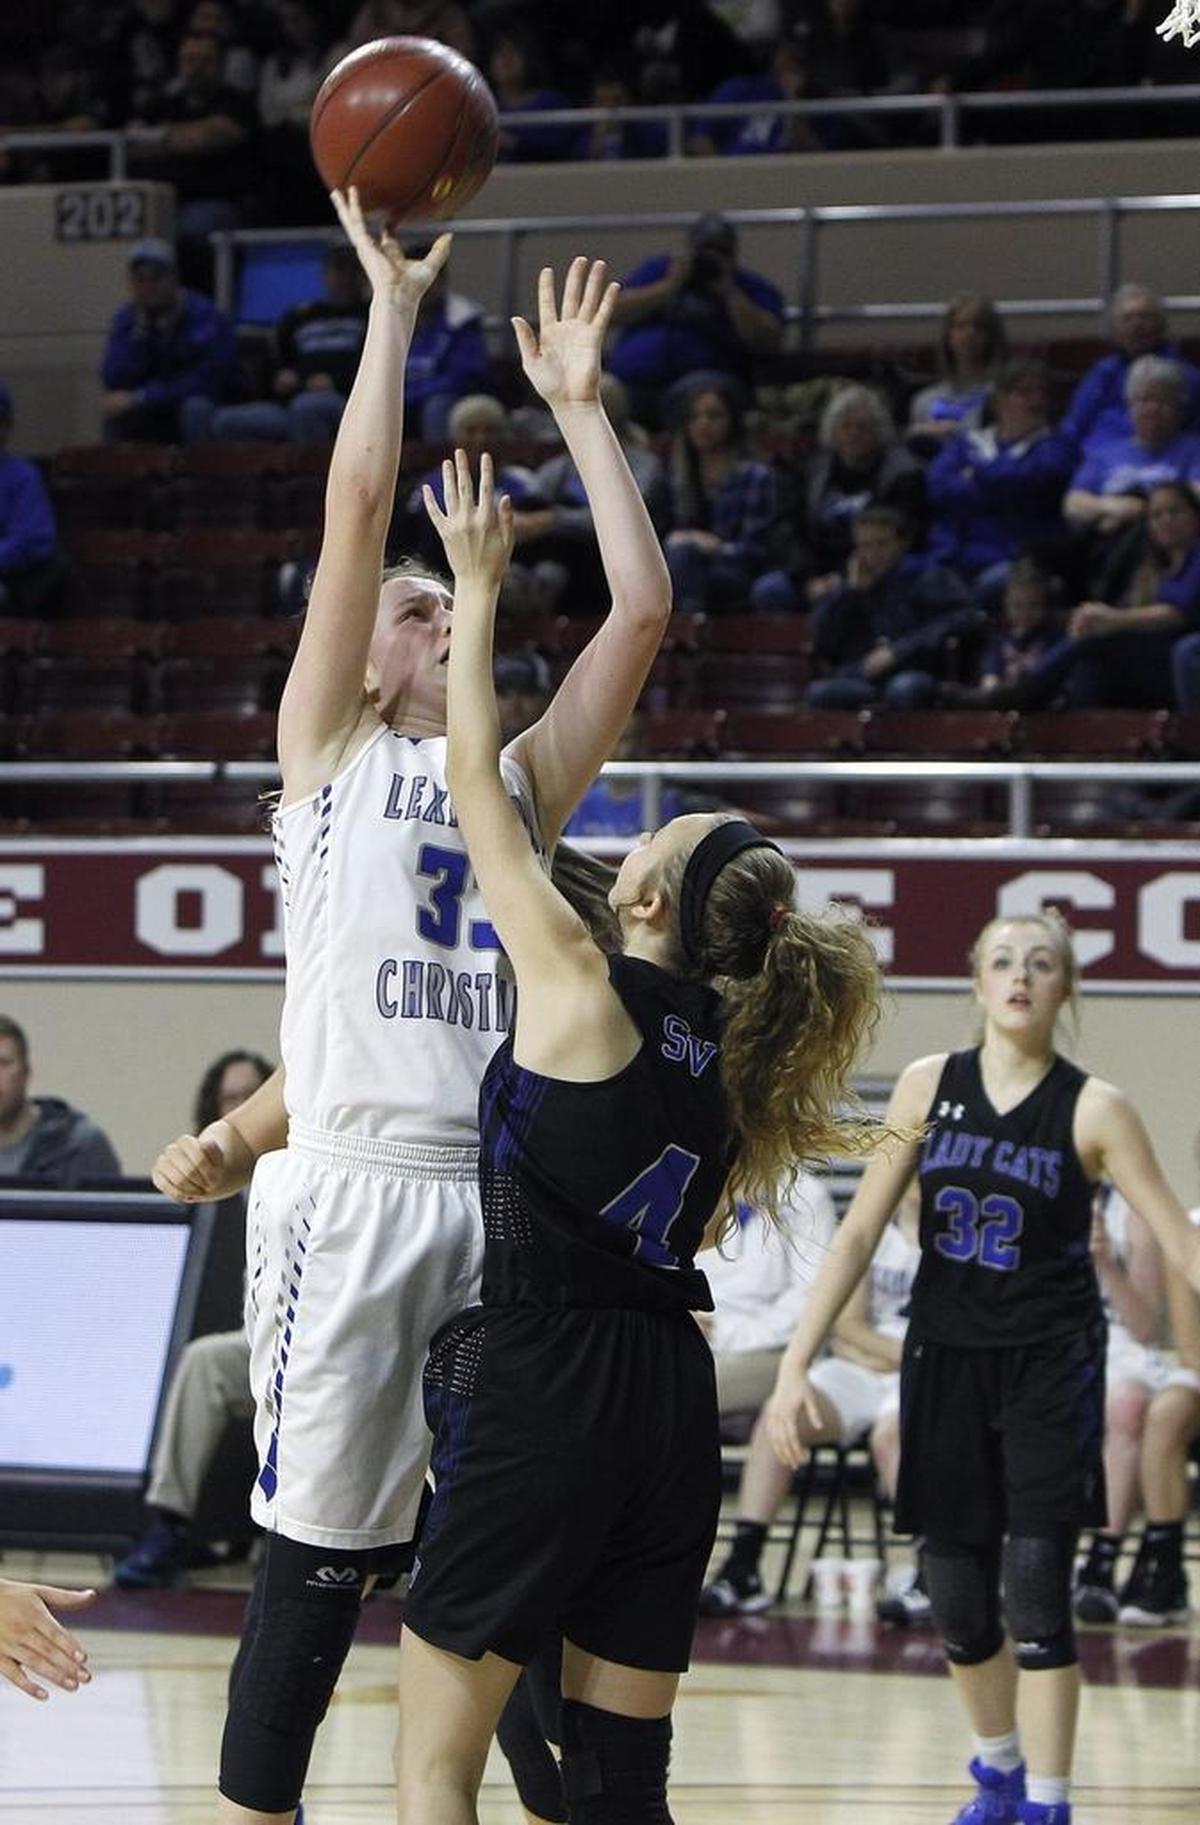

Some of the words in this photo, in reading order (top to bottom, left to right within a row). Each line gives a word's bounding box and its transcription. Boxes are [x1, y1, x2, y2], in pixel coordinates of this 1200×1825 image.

[62, 195, 141, 237] 202
[383, 772, 458, 827] LEX
[661, 1013, 717, 1078] SV
[920, 1128, 993, 1175] LADY
[992, 1140, 1062, 1199] CATS
[599, 1143, 700, 1271] 4
[934, 1185, 1024, 1272] 32
